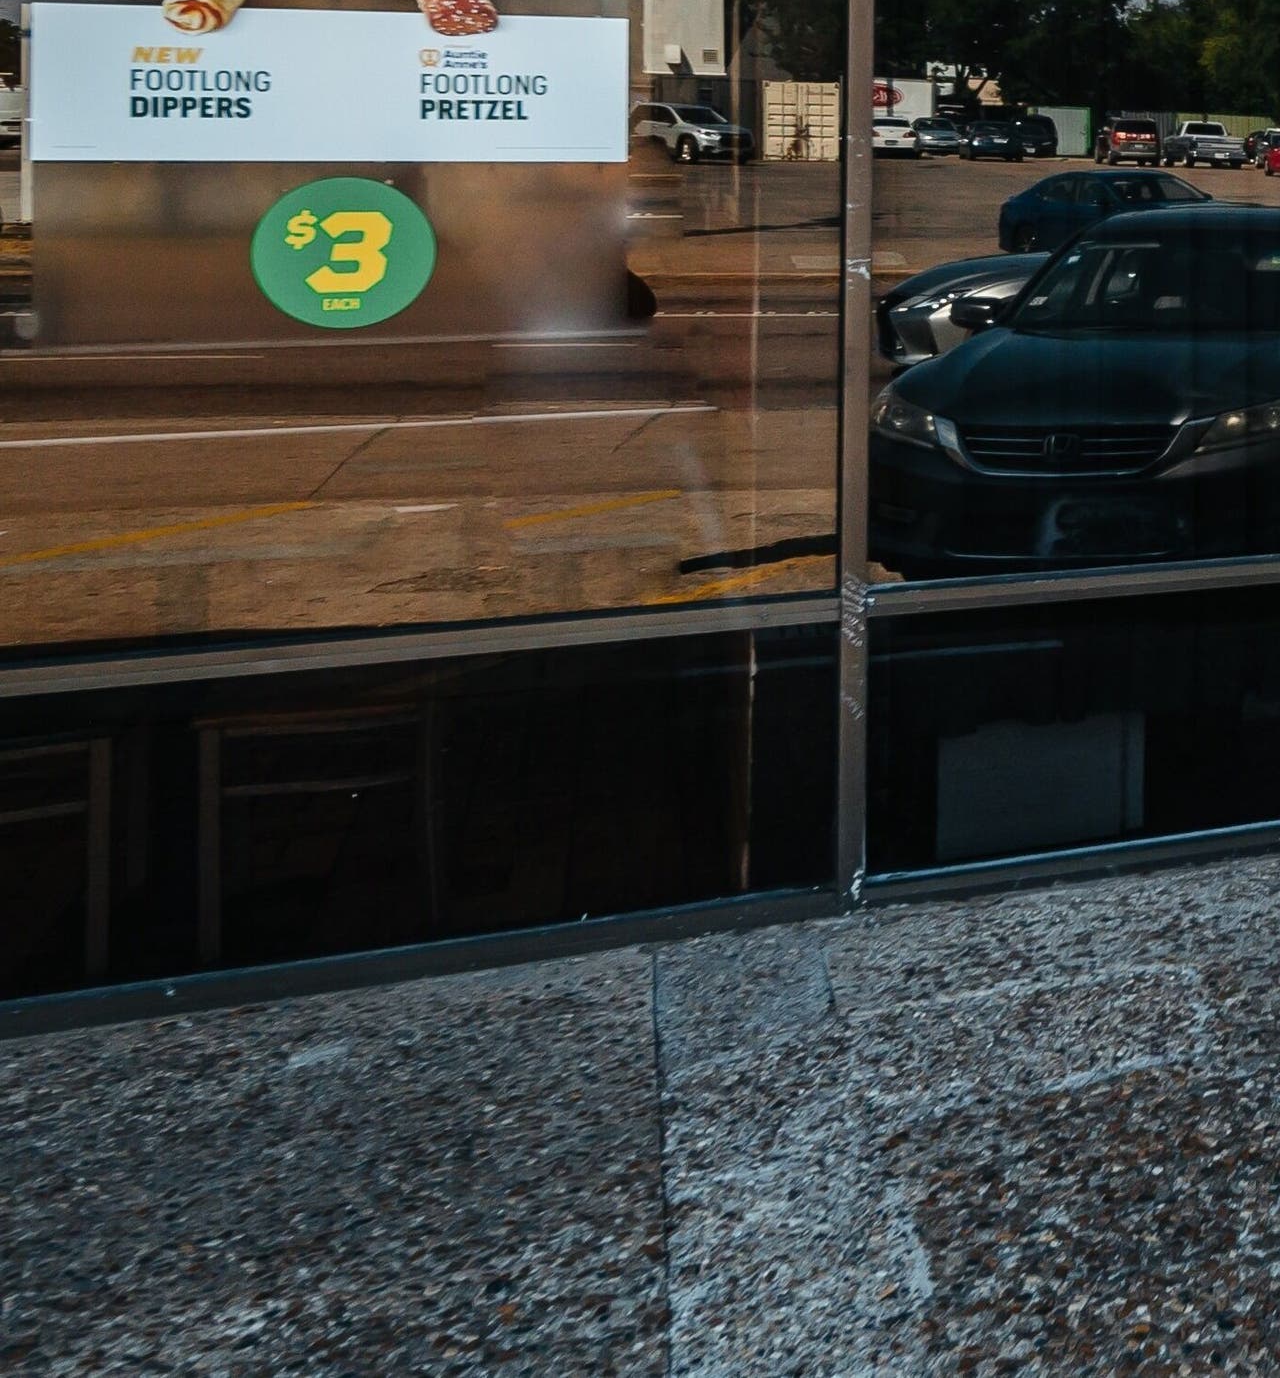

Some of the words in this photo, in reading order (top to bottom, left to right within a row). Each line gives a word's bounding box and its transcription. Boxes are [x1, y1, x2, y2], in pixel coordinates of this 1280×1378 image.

[132, 46, 203, 63] NEW
[130, 69, 271, 92] FOOTLONG
[420, 73, 548, 95] FOOTLONG
[130, 96, 252, 118] DIPPERS
[420, 99, 528, 120] PRETZEL
[284, 210, 393, 294] $3
